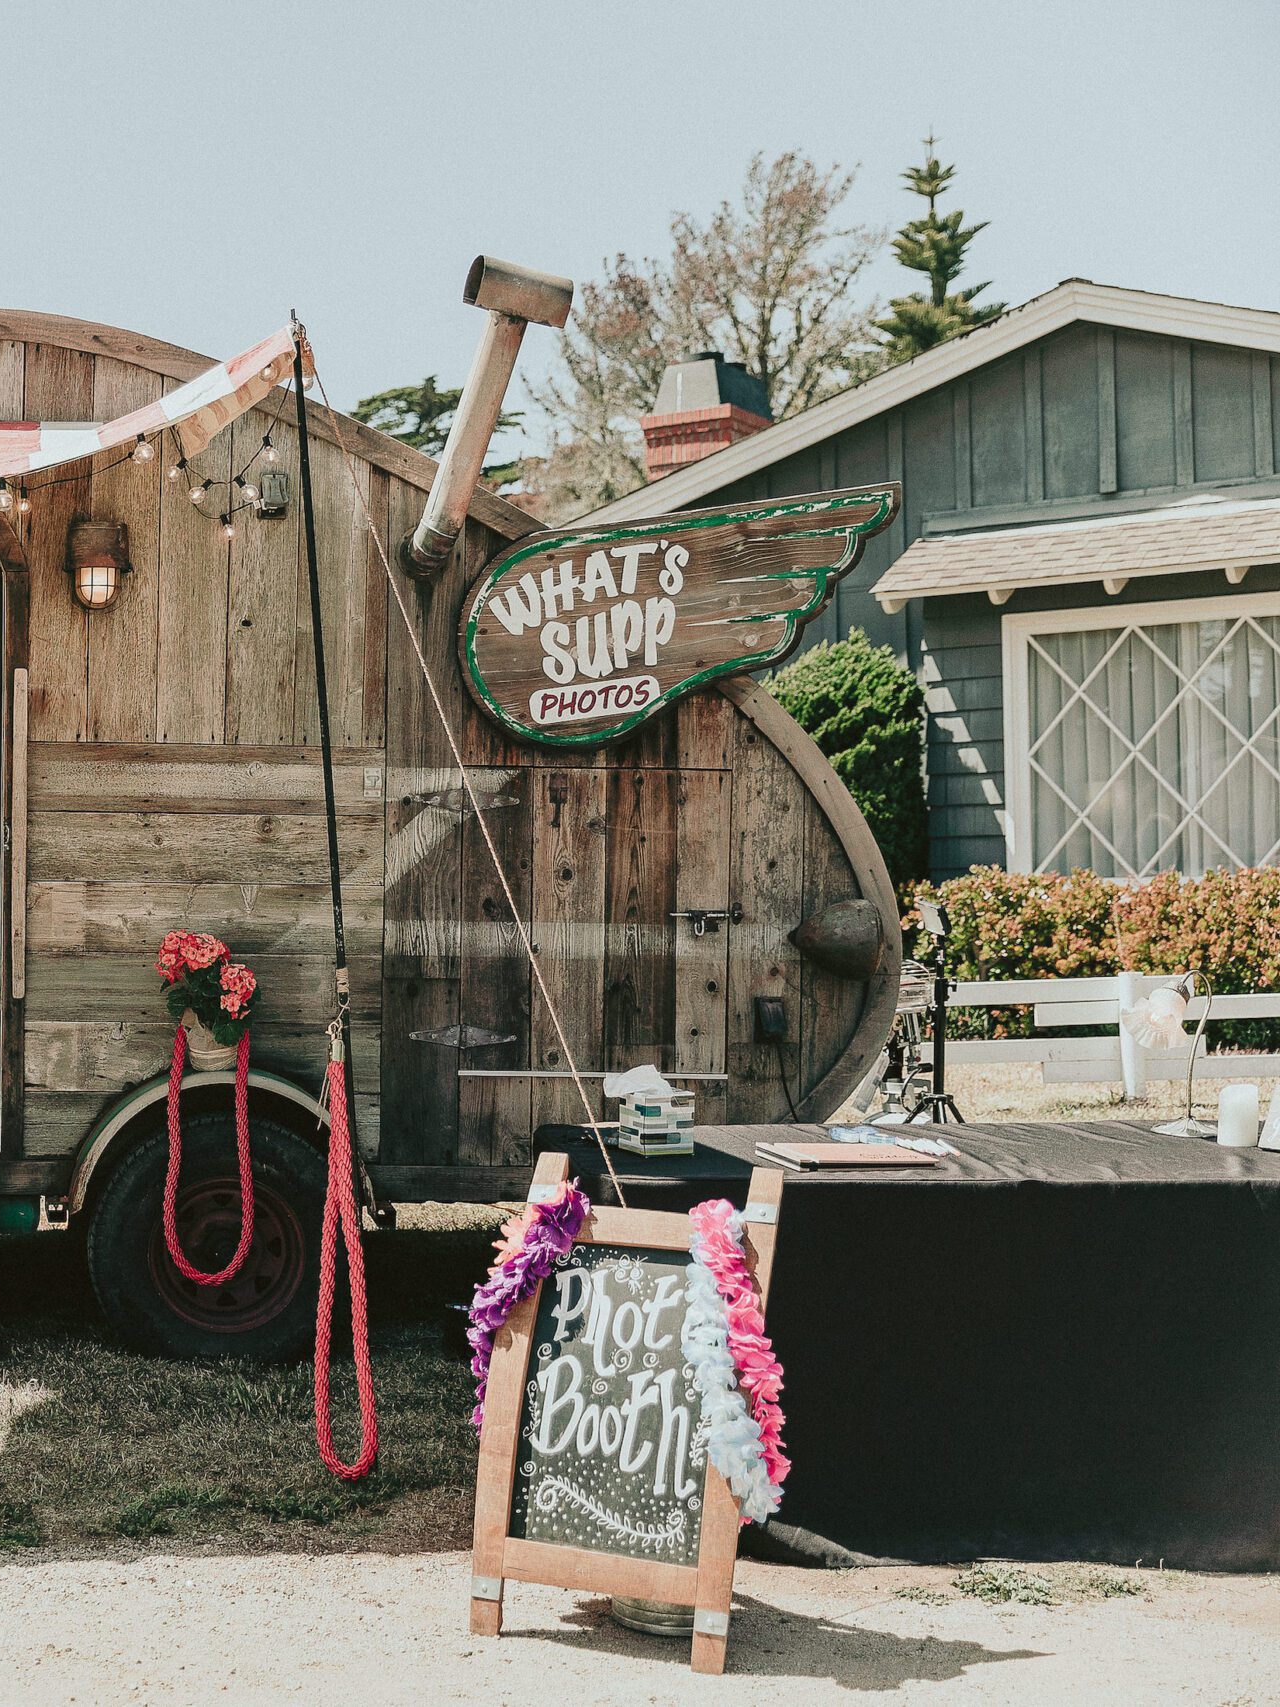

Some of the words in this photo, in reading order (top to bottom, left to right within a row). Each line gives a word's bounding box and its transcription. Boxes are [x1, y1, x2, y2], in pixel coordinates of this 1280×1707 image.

[489, 539, 690, 636] WHAT'S
[539, 597, 677, 685] SUPP
[539, 679, 650, 719] PHOTOS
[551, 1267, 694, 1377] Phot
[530, 1354, 697, 1498] Booth
